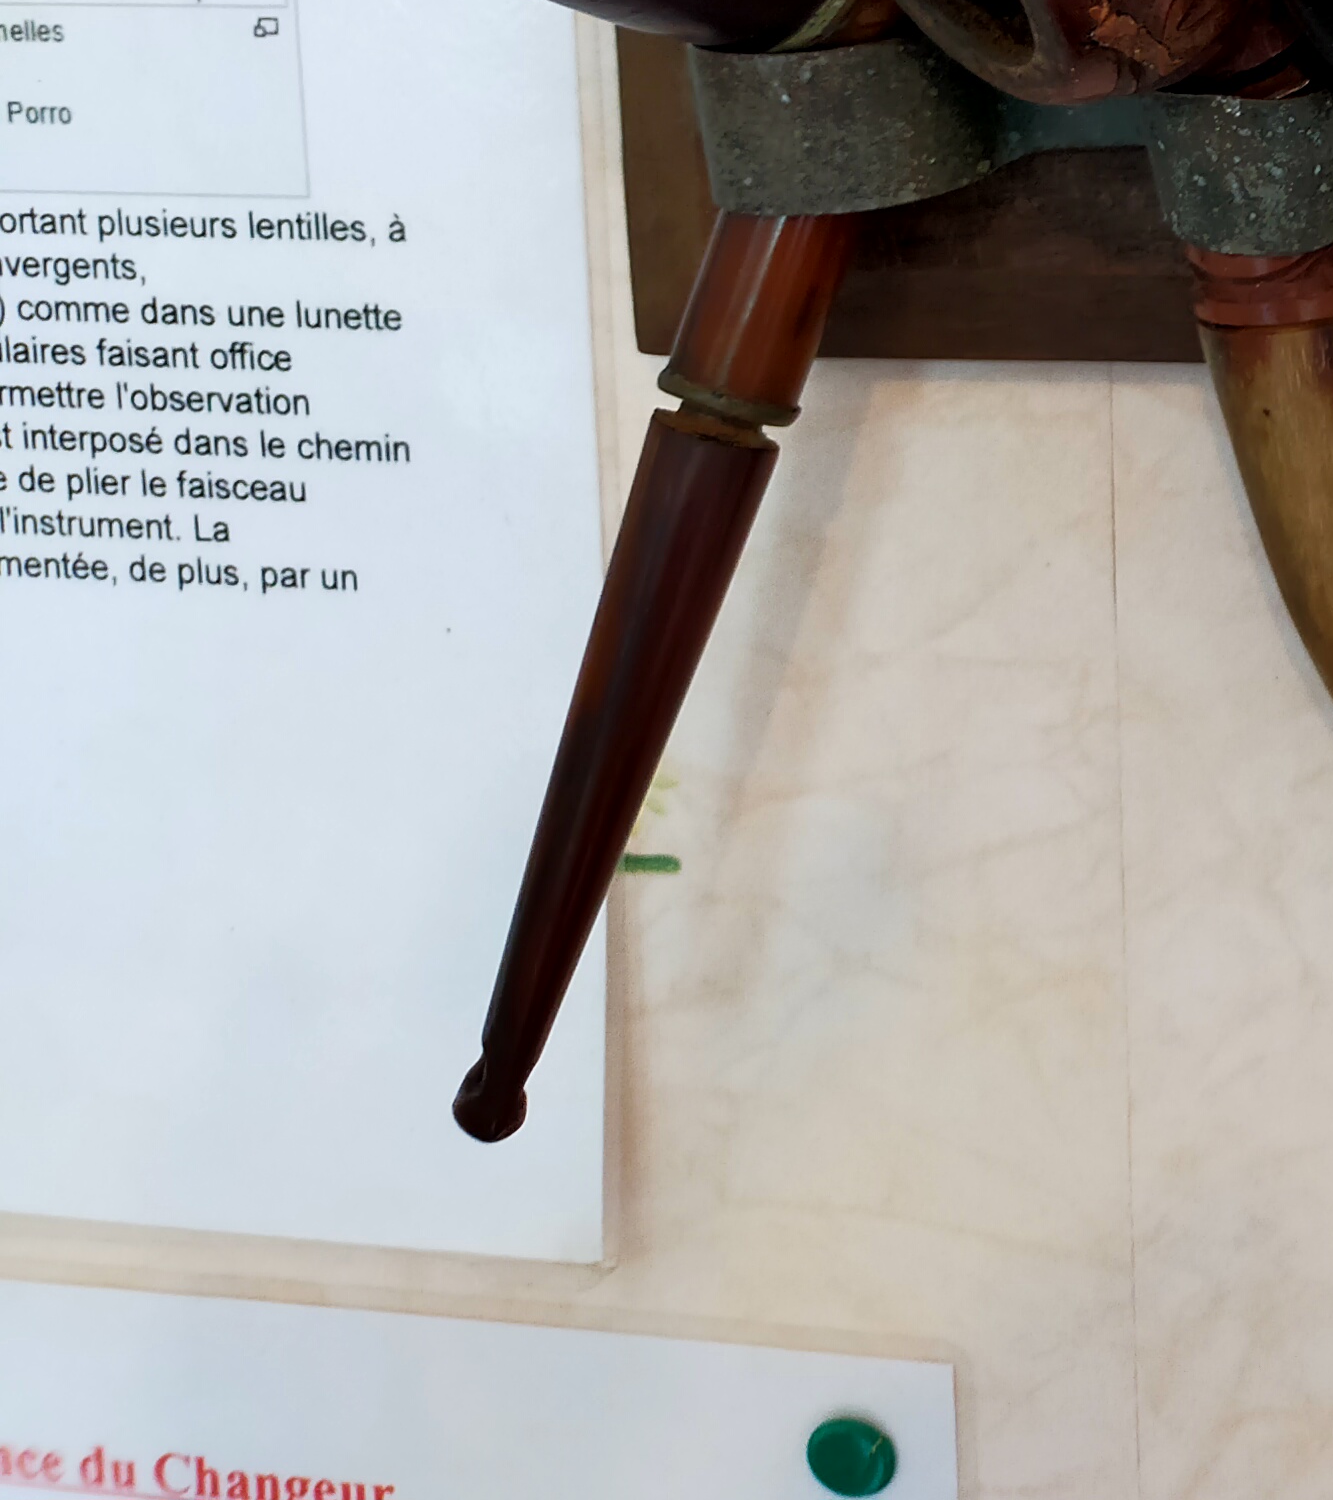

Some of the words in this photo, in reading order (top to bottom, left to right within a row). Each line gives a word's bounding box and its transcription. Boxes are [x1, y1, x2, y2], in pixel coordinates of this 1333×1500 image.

[7, 100, 72, 125] Porro
[97, 207, 238, 243] plusieurs
[247, 210, 376, 247] lentilles,
[388, 213, 407, 243] à
[0, 252, 146, 287] vergents,
[16, 299, 130, 324] comme
[140, 295, 216, 327] dans
[227, 305, 286, 329] une
[295, 299, 402, 332] lunette
[0, 334, 87, 366] laires
[95, 337, 200, 370] faisant
[209, 340, 293, 373] office
[115, 381, 311, 416] l'observation
[21, 421, 164, 460] interposé
[173, 426, 249, 458] dans
[259, 429, 286, 459] le
[297, 431, 411, 464] chemin
[17, 464, 56, 494] de
[66, 466, 132, 502] plier
[140, 468, 167, 498] le
[175, 469, 307, 503] faisceau
[0, 505, 181, 542] l'instrument.
[193, 513, 231, 543] La
[128, 554, 167, 584] de
[177, 556, 248, 592] plus,
[260, 566, 311, 595] par
[320, 568, 358, 592] un
[79, 1444, 137, 1490] du
